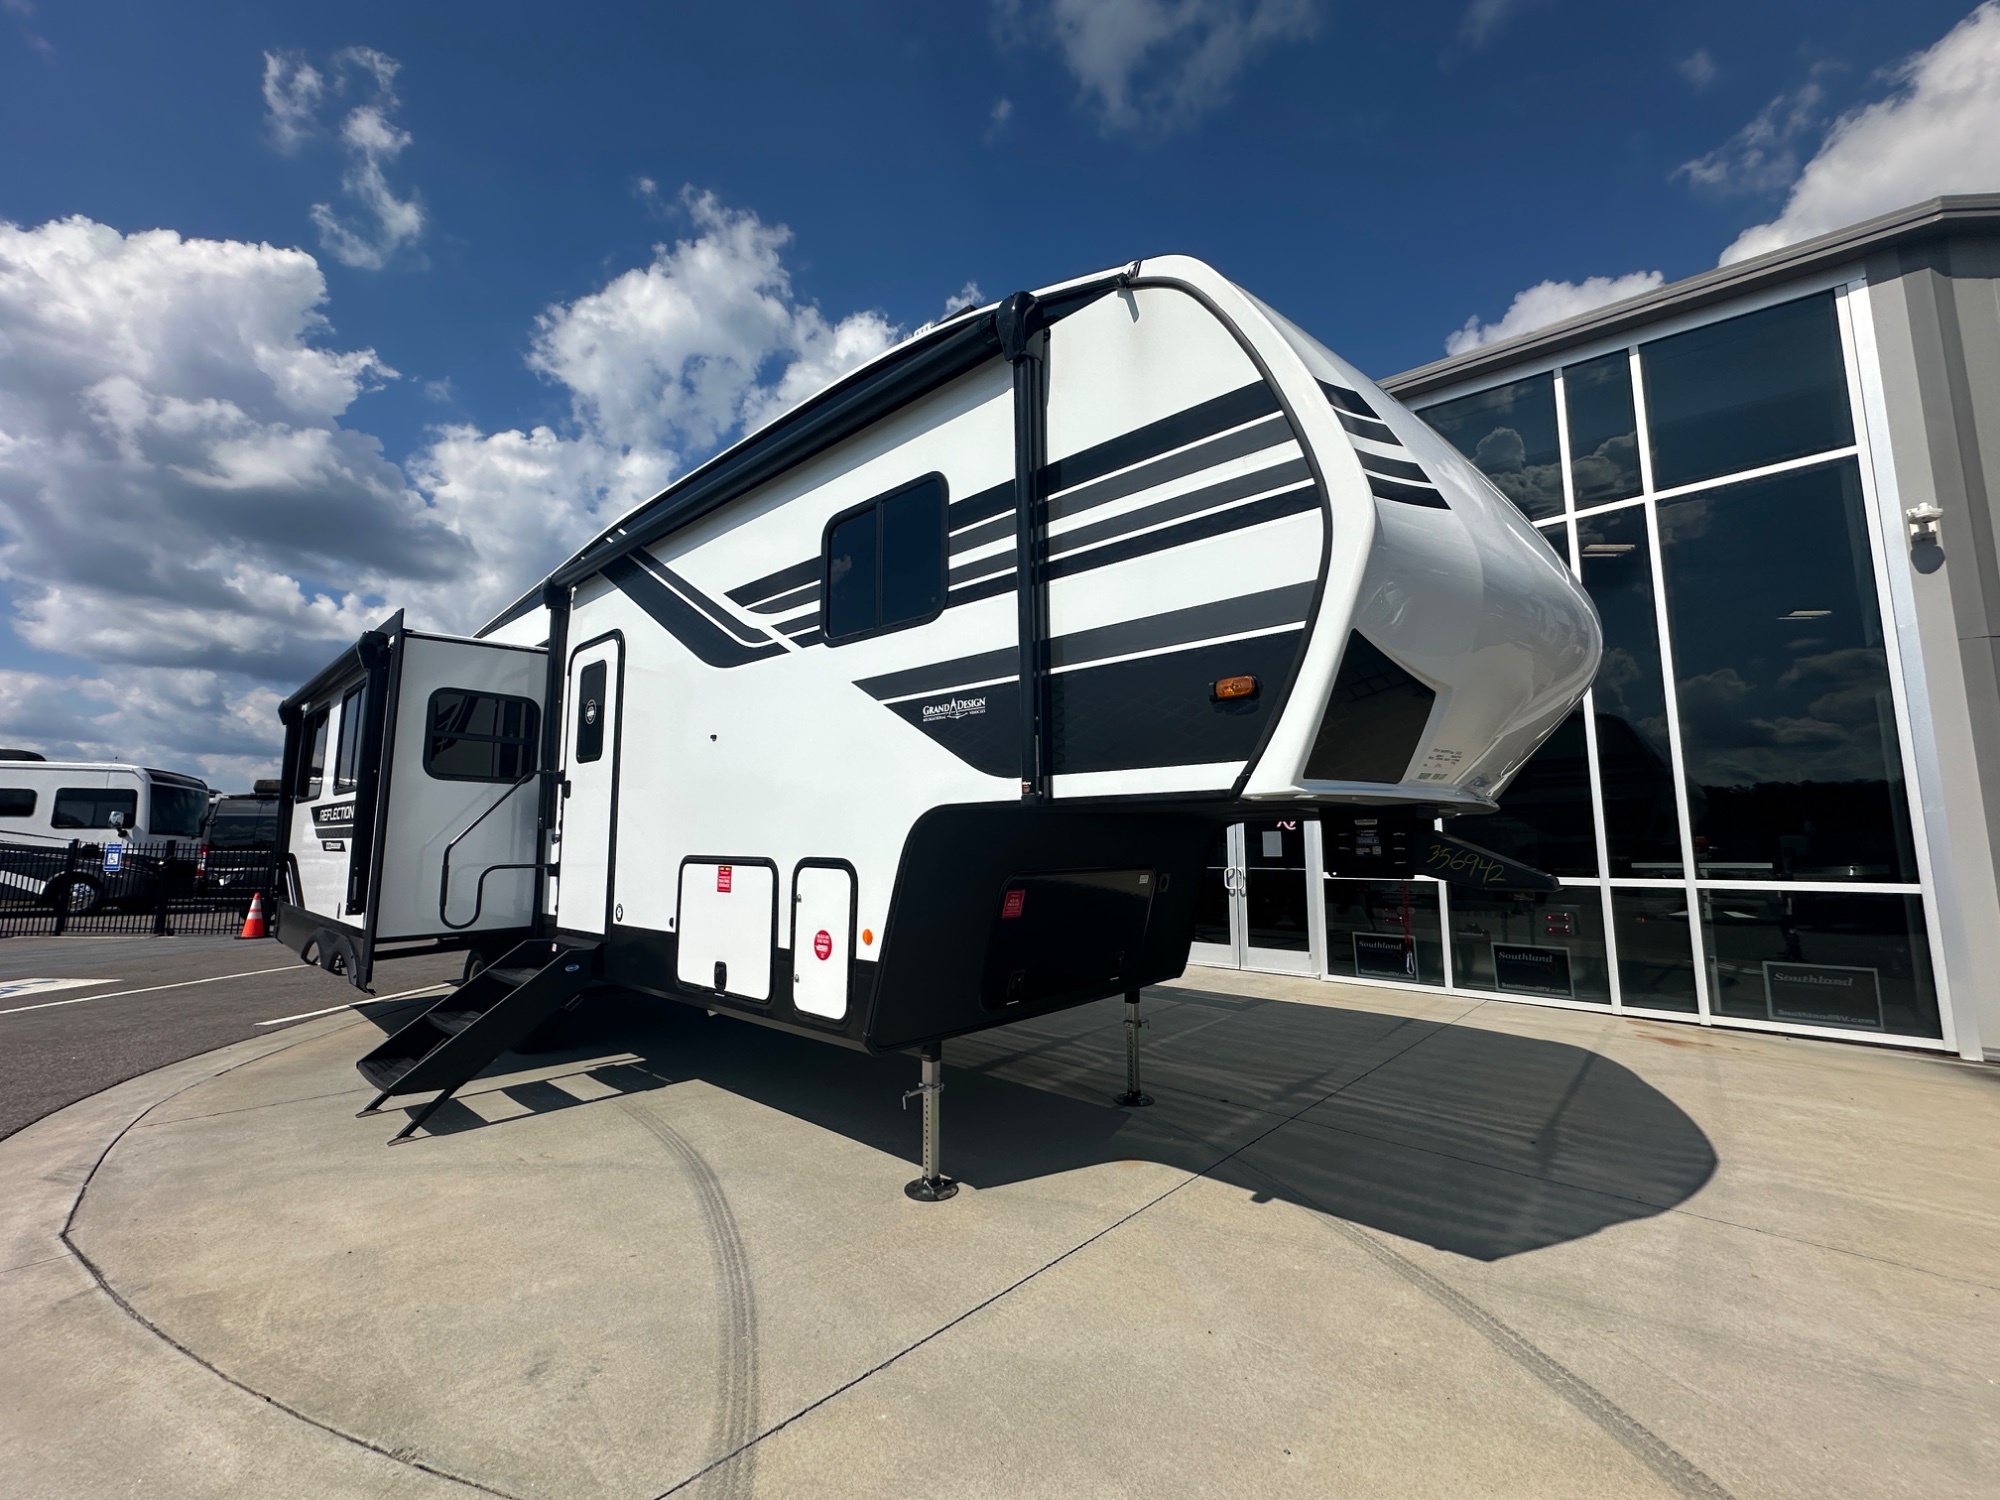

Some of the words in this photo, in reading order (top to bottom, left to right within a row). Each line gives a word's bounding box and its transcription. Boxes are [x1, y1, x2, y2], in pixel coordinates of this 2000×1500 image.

[922, 704, 950, 715] GRAND
[957, 697, 986, 710] DESIGN
[319, 805, 355, 822] REFLECTION
[1426, 844, 1506, 884] 356942
[1358, 940, 1402, 951] Southland
[1498, 951, 1553, 963] Southland
[1773, 972, 1853, 987] Southland
[1777, 1008, 1876, 1025] SouthlandRV.com
